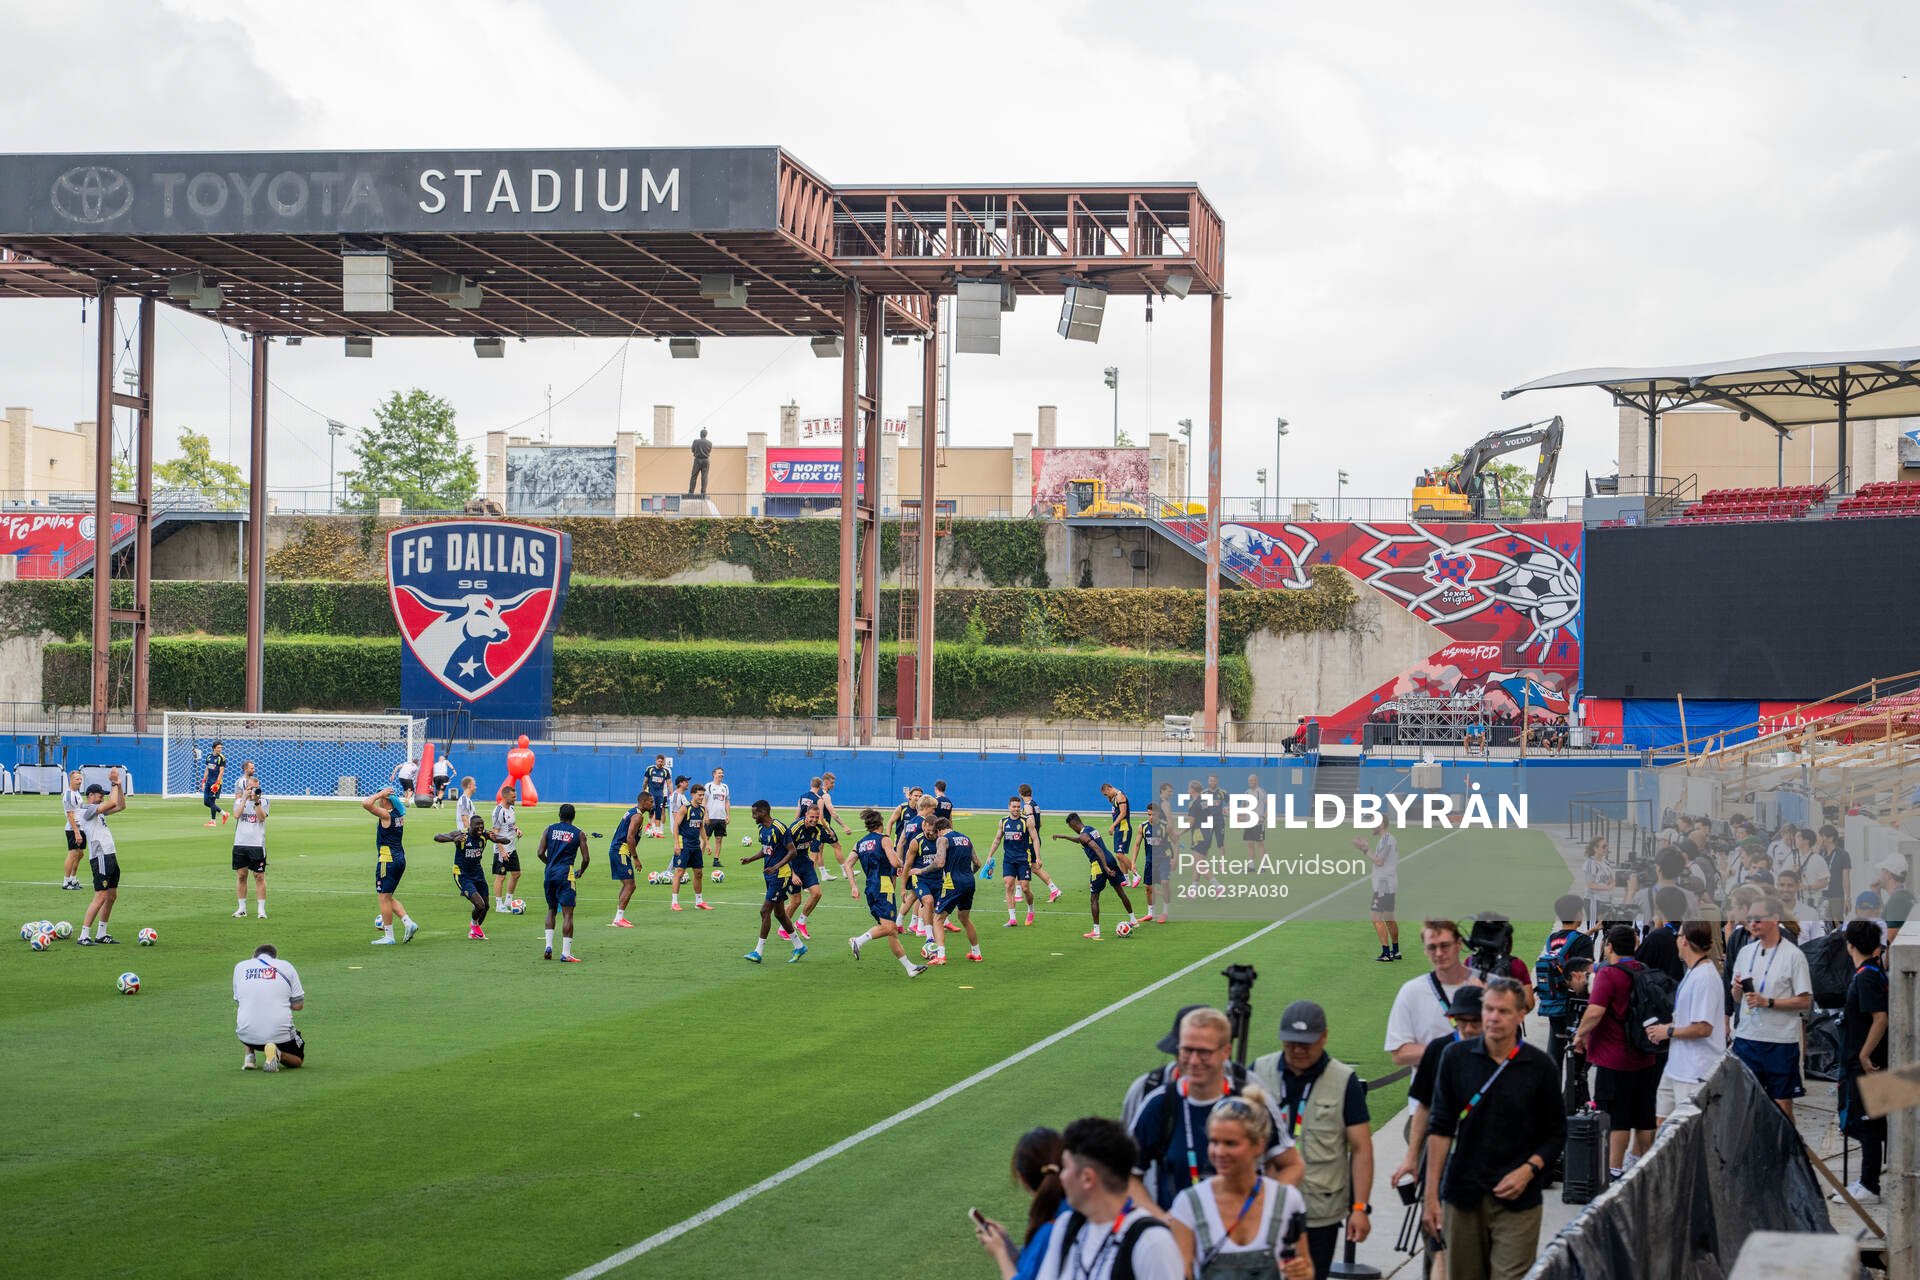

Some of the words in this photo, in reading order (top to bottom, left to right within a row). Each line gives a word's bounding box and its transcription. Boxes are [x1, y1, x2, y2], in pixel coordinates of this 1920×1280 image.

[153, 170, 385, 218] TOYOTA
[418, 167, 680, 214] STADIUM
[1505, 436, 1532, 447] VOLVO
[793, 464, 839, 472] NORTH
[791, 472, 820, 481] BOX
[9, 516, 30, 541] FC
[402, 535, 433, 577] FC
[447, 533, 546, 577] DALLAS
[458, 579, 488, 590] 96
[1442, 595, 1475, 606] original
[245, 973, 263, 981] SPEL
